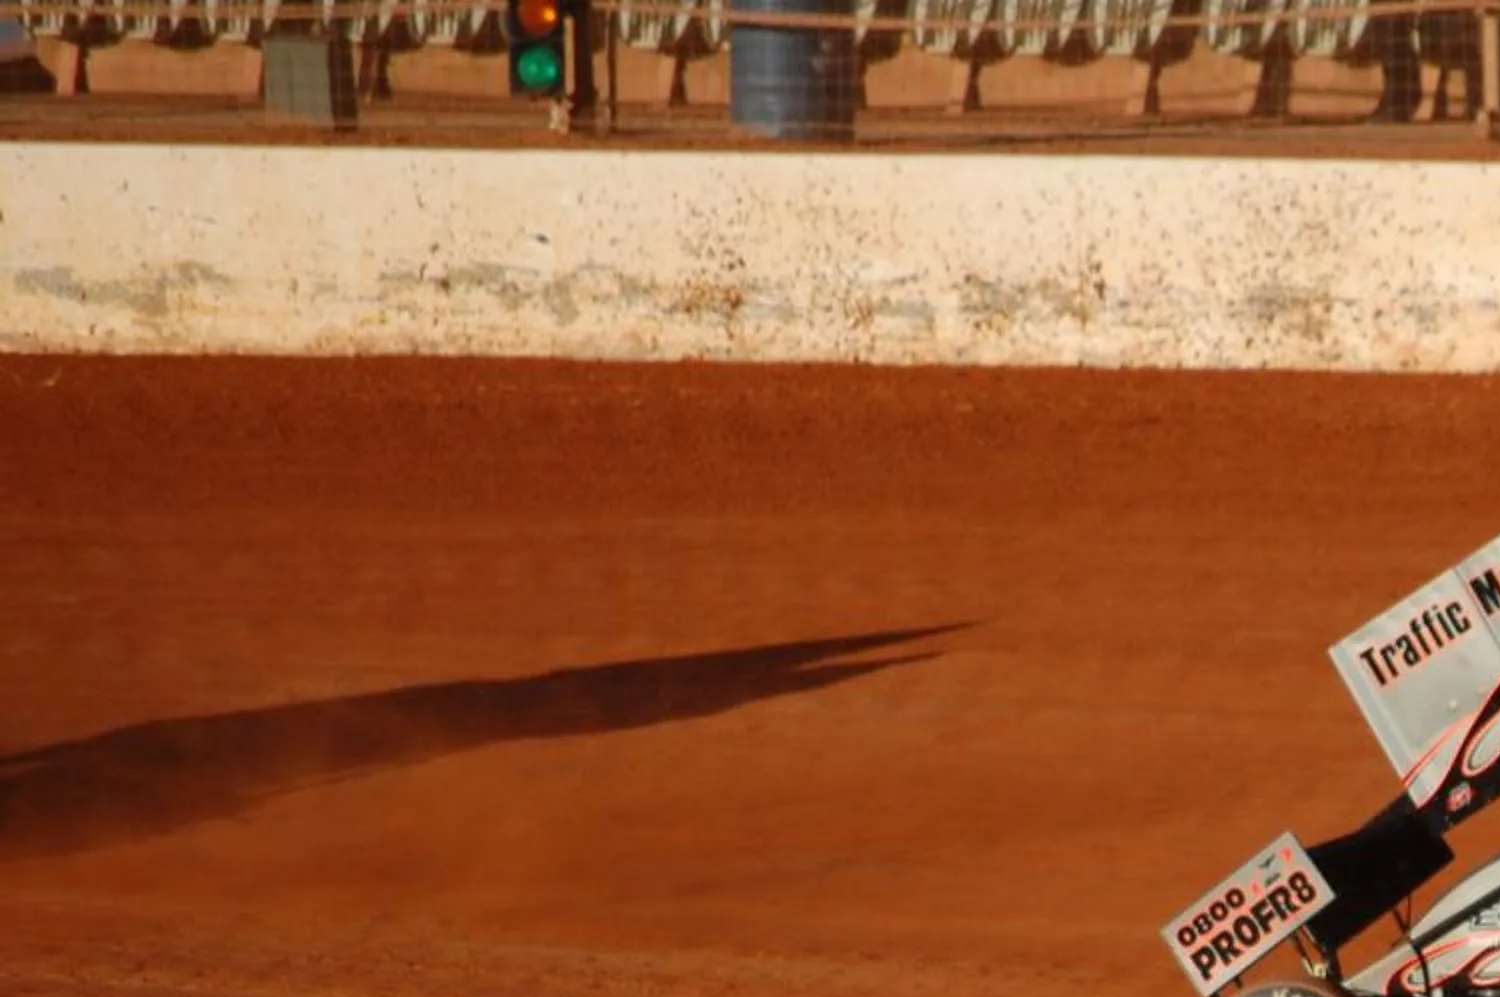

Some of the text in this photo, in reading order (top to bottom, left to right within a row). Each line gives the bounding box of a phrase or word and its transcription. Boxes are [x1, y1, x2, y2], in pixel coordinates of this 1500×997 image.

[1360, 600, 1472, 687] Traffic
[1176, 887, 1246, 948] 0800
[1190, 870, 1317, 981] PROFR8
